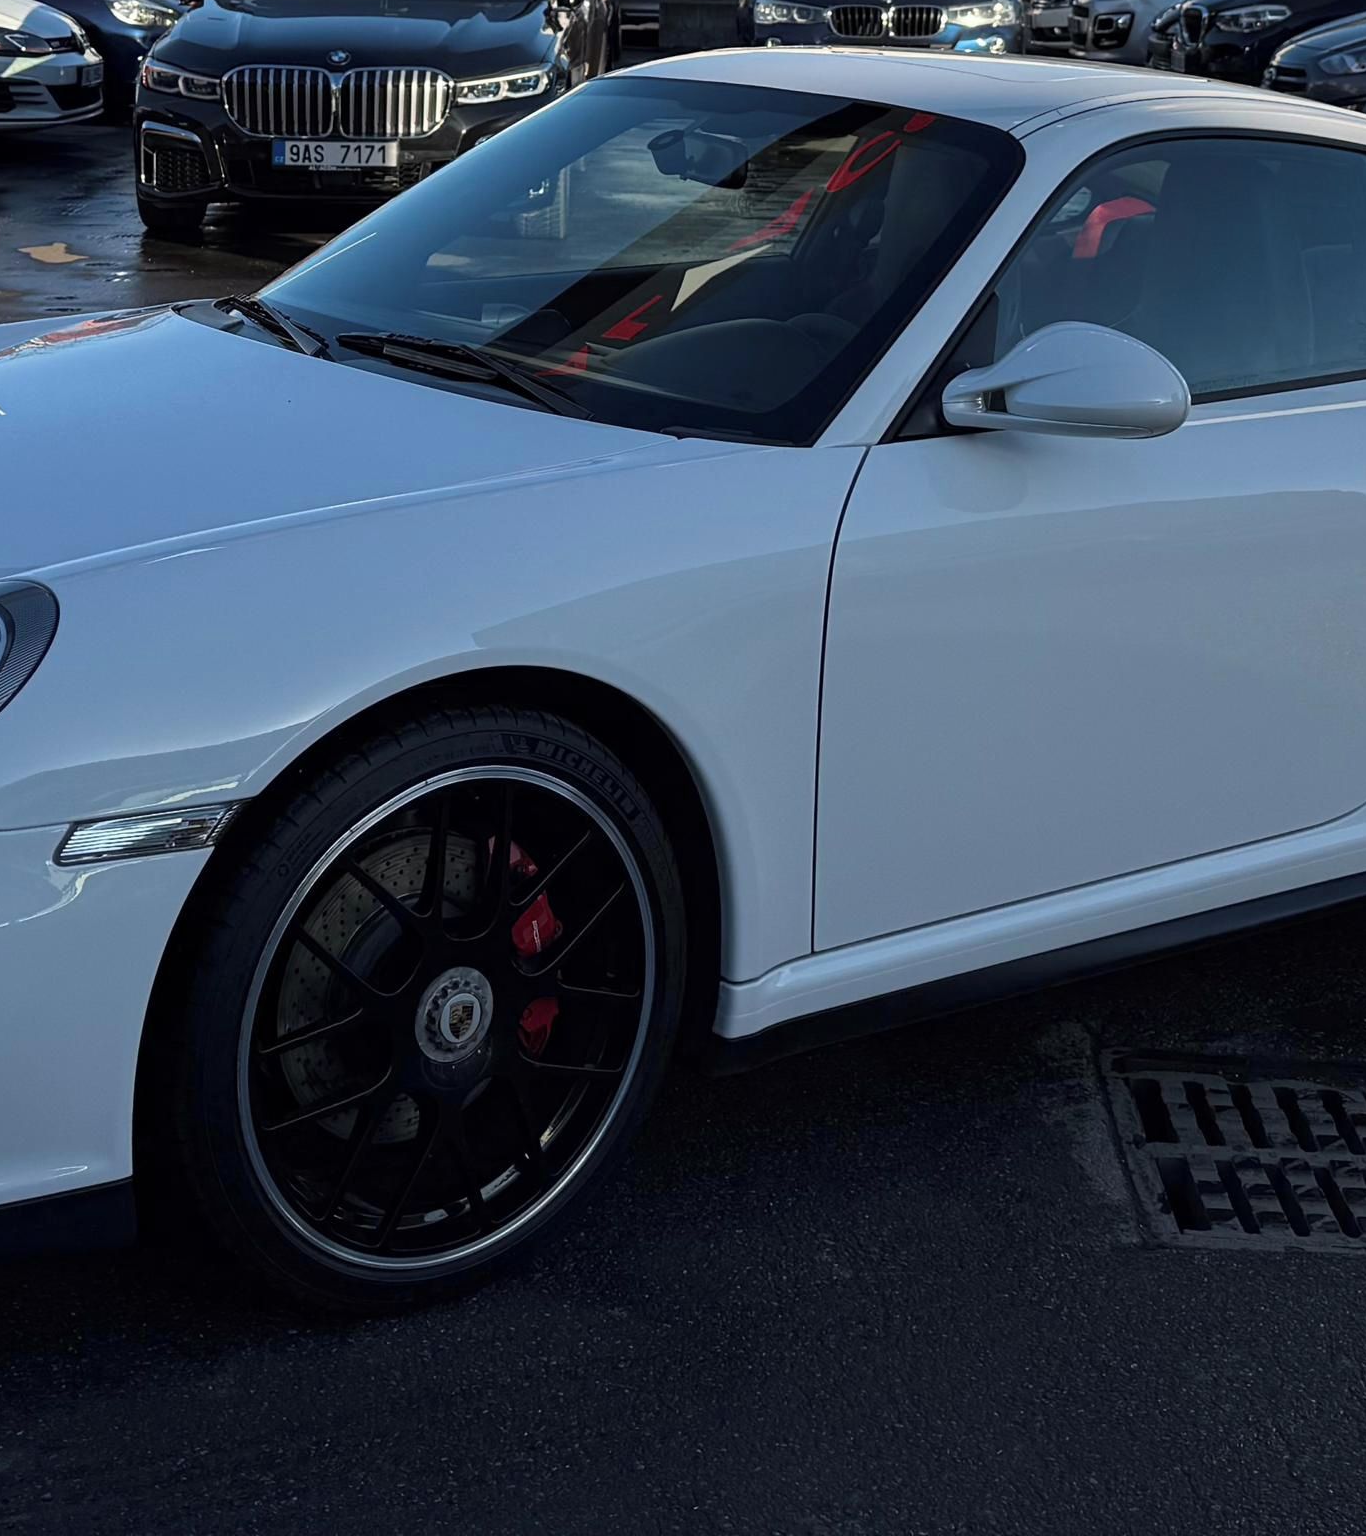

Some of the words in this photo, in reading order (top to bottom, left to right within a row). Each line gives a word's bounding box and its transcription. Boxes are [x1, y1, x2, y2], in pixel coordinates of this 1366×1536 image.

[289, 144, 325, 163] 9AS
[339, 144, 387, 164] 7171
[535, 741, 637, 821] MICHELIN
